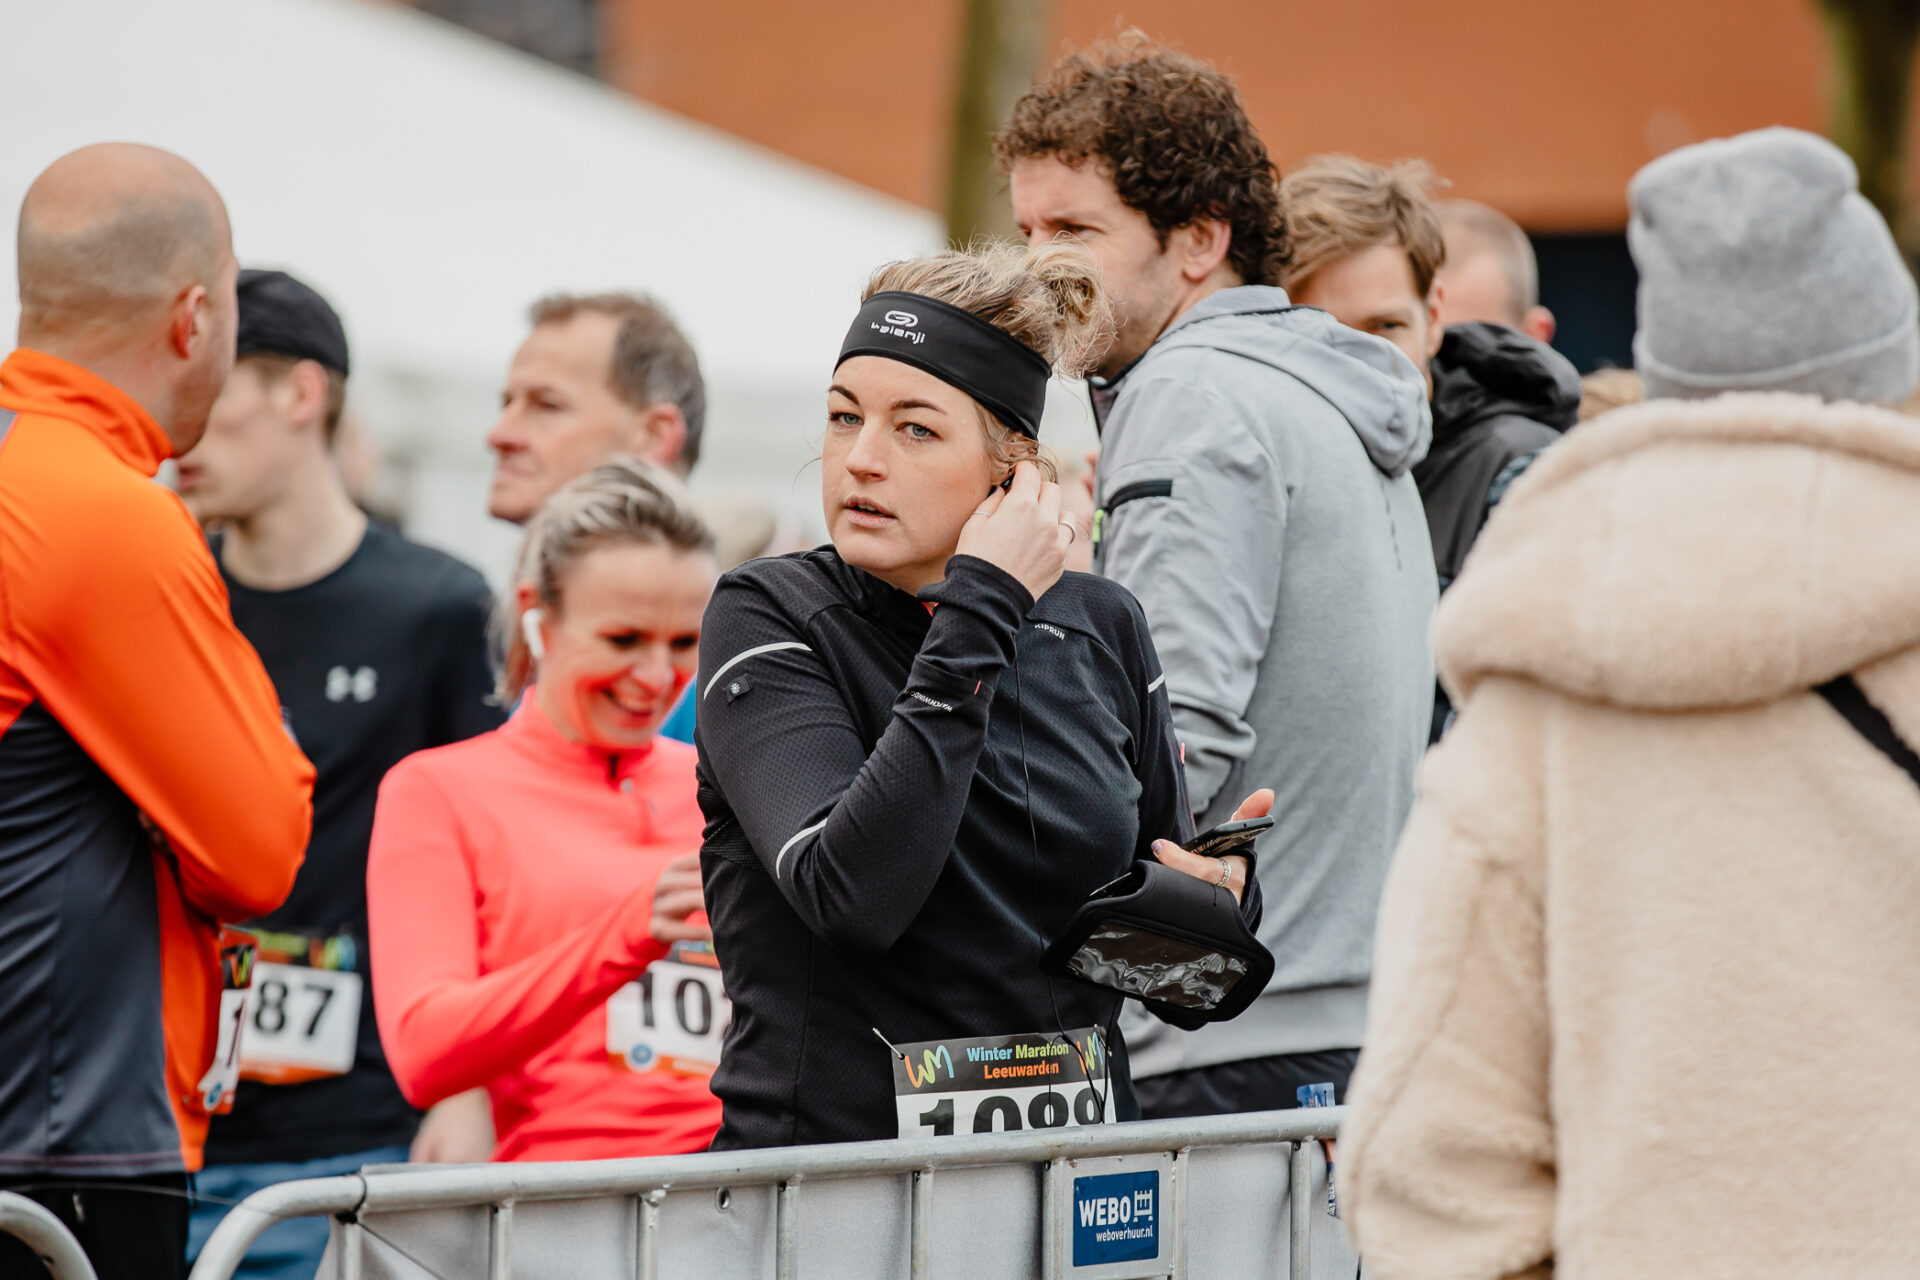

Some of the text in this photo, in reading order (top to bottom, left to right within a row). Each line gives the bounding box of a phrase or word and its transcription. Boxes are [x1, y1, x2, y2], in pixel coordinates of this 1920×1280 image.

[966, 1042, 1069, 1062] Winter Marathon
[984, 1060, 1060, 1080] Leeuwarden
[1079, 1196, 1132, 1228] WEBO
[1096, 1225, 1153, 1242] weboverhuur.nl
